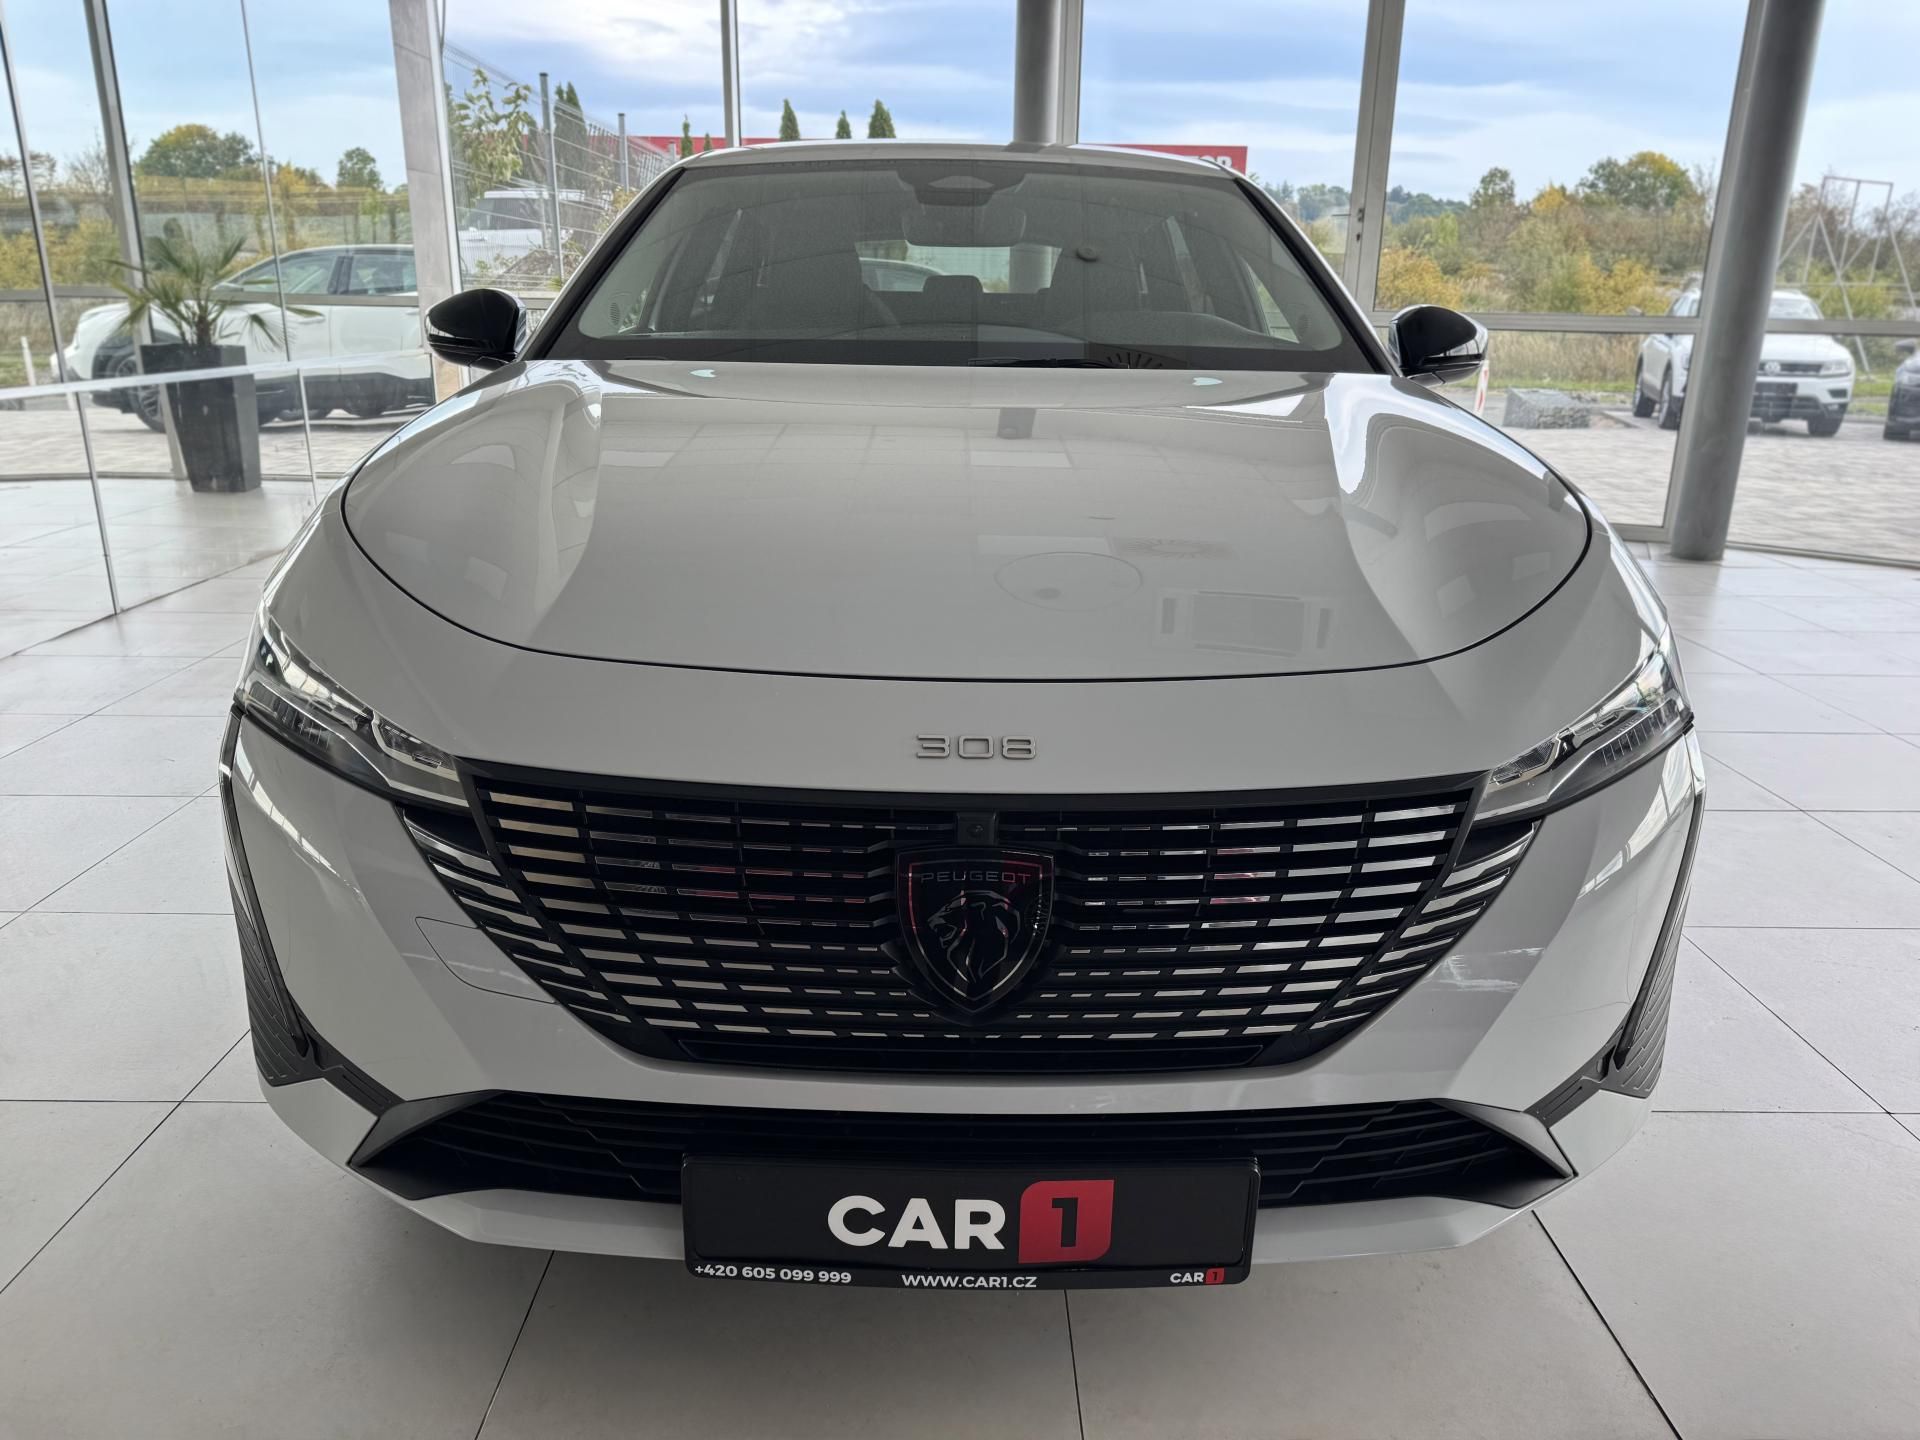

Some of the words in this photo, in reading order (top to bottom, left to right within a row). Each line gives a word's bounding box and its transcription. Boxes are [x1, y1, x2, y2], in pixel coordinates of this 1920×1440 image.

[916, 734, 1036, 760] 308
[920, 870, 1031, 884] PEUGEOT
[694, 1264, 738, 1277] +420
[742, 1266, 776, 1280] 605
[779, 1268, 814, 1282] 099
[818, 1271, 852, 1284] 999
[901, 1274, 1037, 1289] WWW.CAR1.CZ
